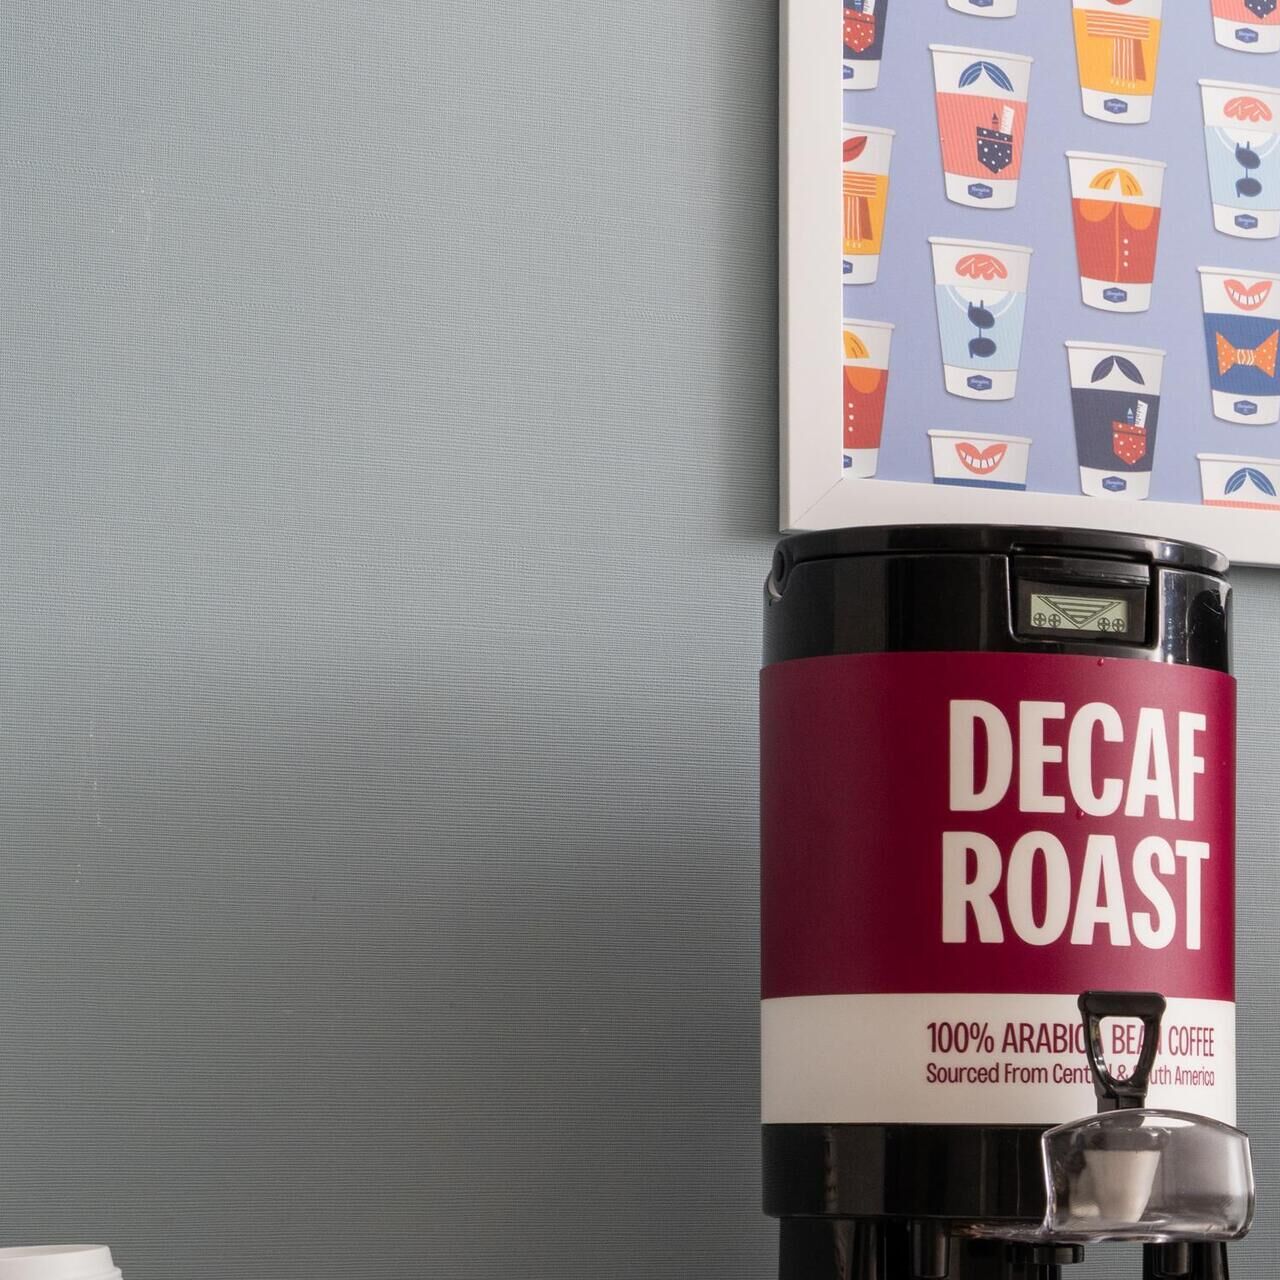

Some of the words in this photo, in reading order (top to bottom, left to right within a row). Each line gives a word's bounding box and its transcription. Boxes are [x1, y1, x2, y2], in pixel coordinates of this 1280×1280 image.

[949, 699, 1206, 821] DECAF
[942, 830, 1210, 950] ROAST
[926, 1022, 995, 1054] 100%
[1002, 1022, 1104, 1054] ARABIC
[1168, 1025, 1215, 1058] COFFEE
[926, 1062, 1000, 1084] Sourced
[1005, 1062, 1048, 1084] From
[1054, 1063, 1117, 1085] Centl
[1117, 1065, 1129, 1085] &
[1174, 1066, 1215, 1087] America
